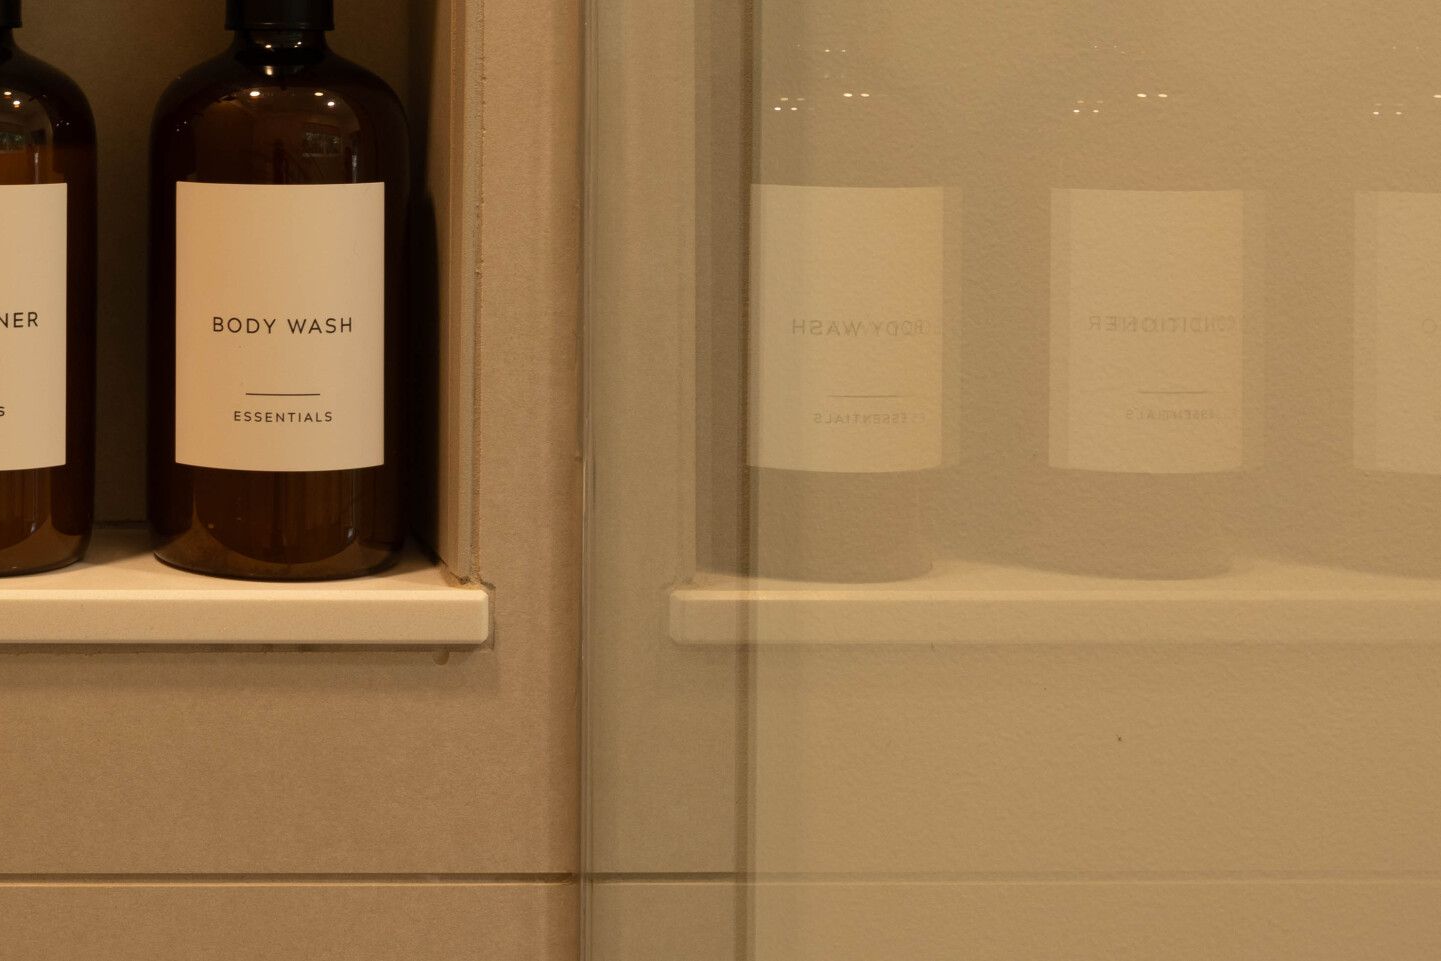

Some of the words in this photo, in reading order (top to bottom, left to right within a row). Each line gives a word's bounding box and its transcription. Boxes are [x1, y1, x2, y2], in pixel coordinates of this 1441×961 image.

[213, 317, 276, 334] BODY
[287, 317, 352, 334] WASH
[233, 410, 332, 423] ESSENTIALS
